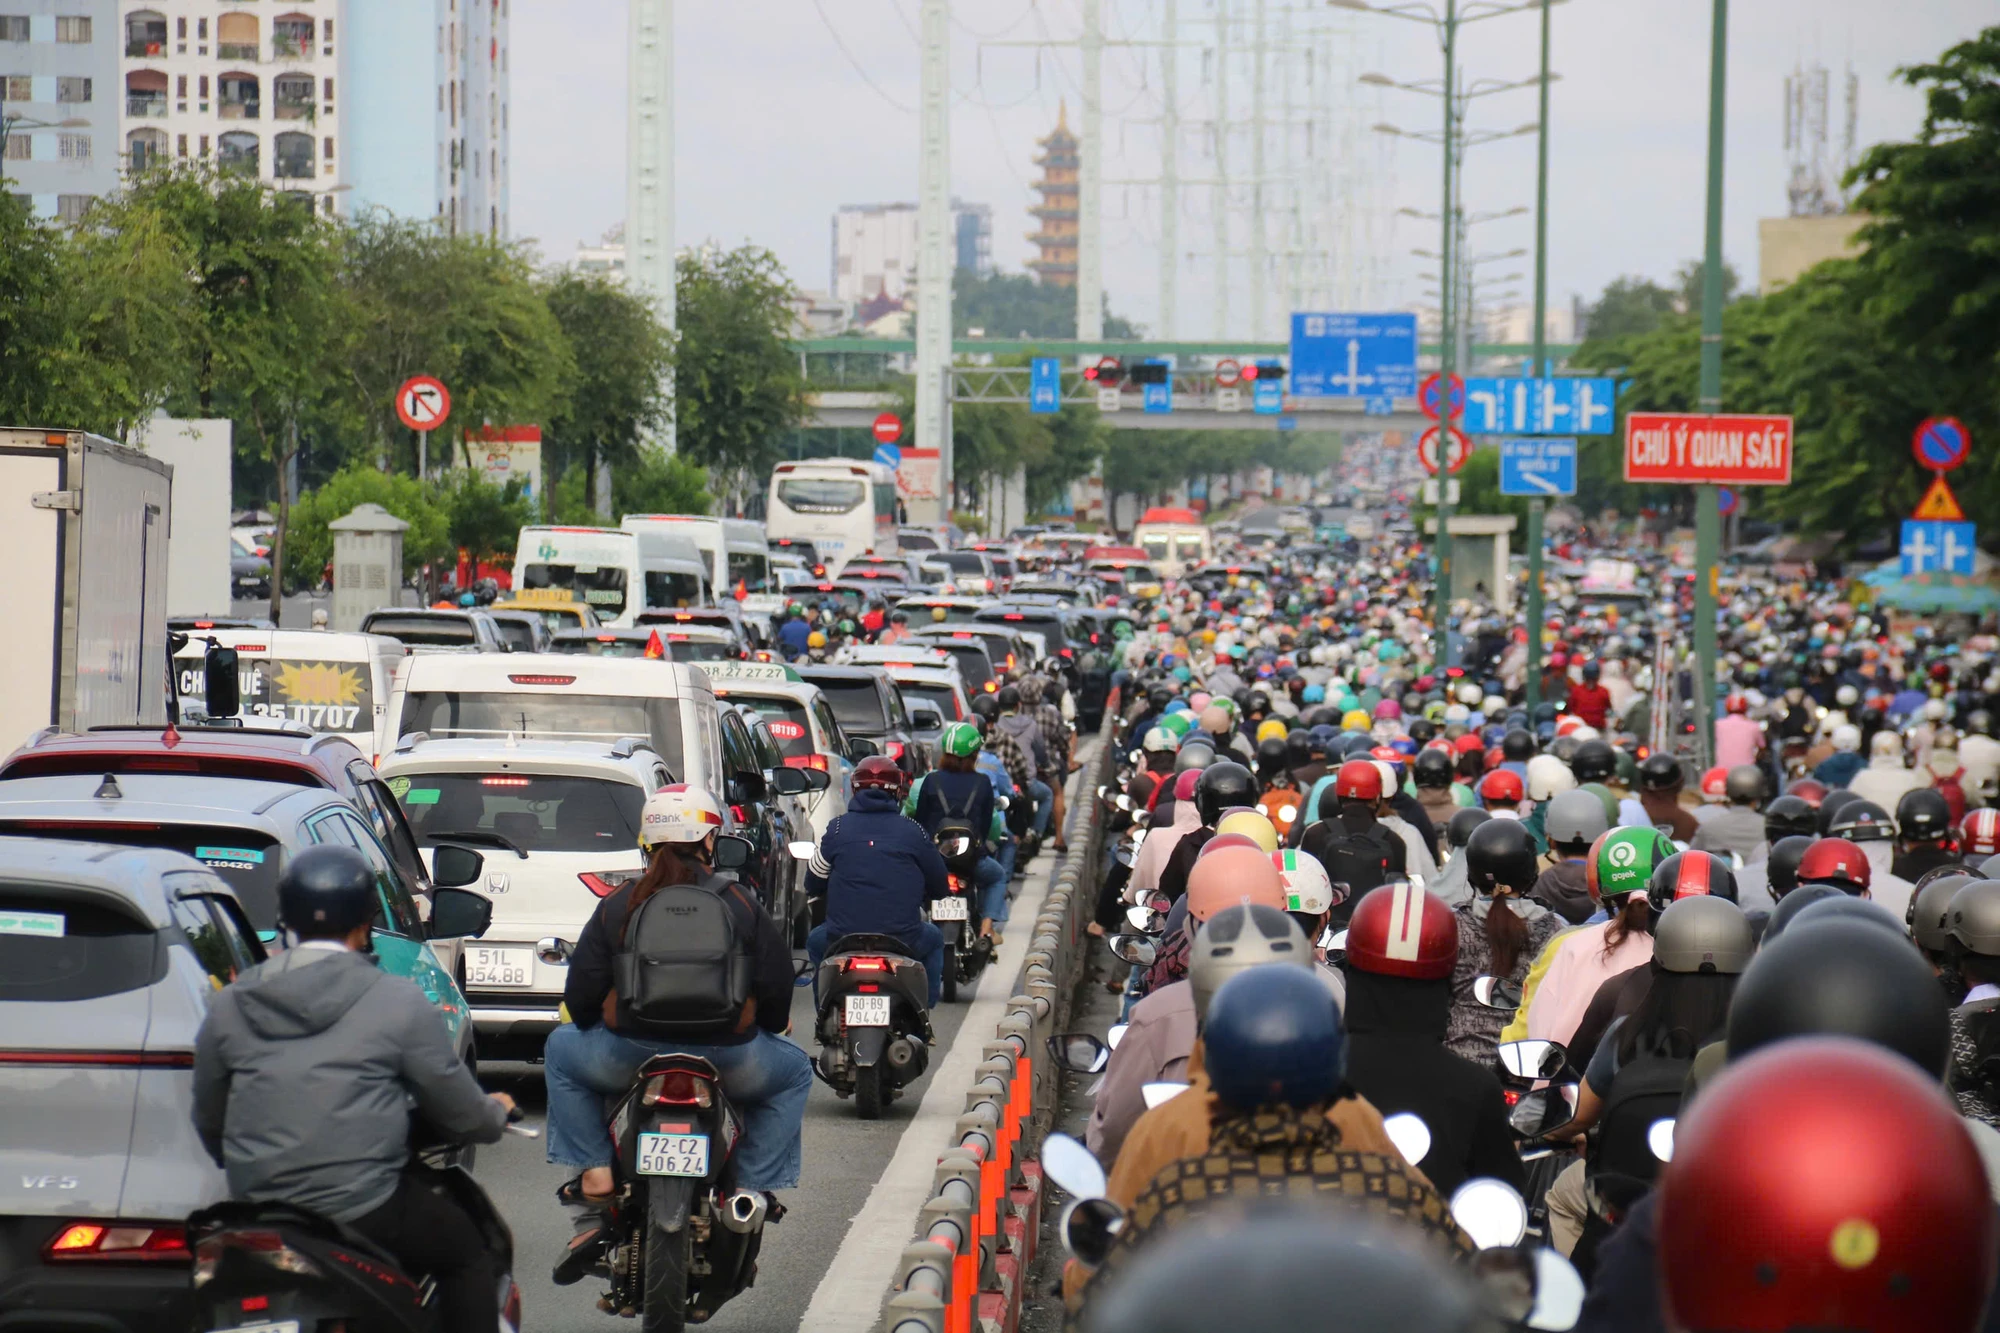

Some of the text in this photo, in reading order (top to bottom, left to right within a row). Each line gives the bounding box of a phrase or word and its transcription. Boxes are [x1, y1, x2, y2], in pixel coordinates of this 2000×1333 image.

[1632, 422, 1785, 469] CHÚ Ý QUAN SÁT
[746, 668, 762, 678] 27
[766, 668, 782, 678] 27
[181, 668, 262, 696] CH UÊ
[770, 724, 797, 737] 18119
[205, 860, 253, 870] 11042G
[1612, 870, 1637, 882] gojek
[479, 949, 511, 966] 51L
[852, 997, 884, 1010] 60-B9
[848, 1010, 888, 1024] 794.47
[650, 1137, 698, 1155] 72-C2
[642, 1155, 704, 1174] 506.24
